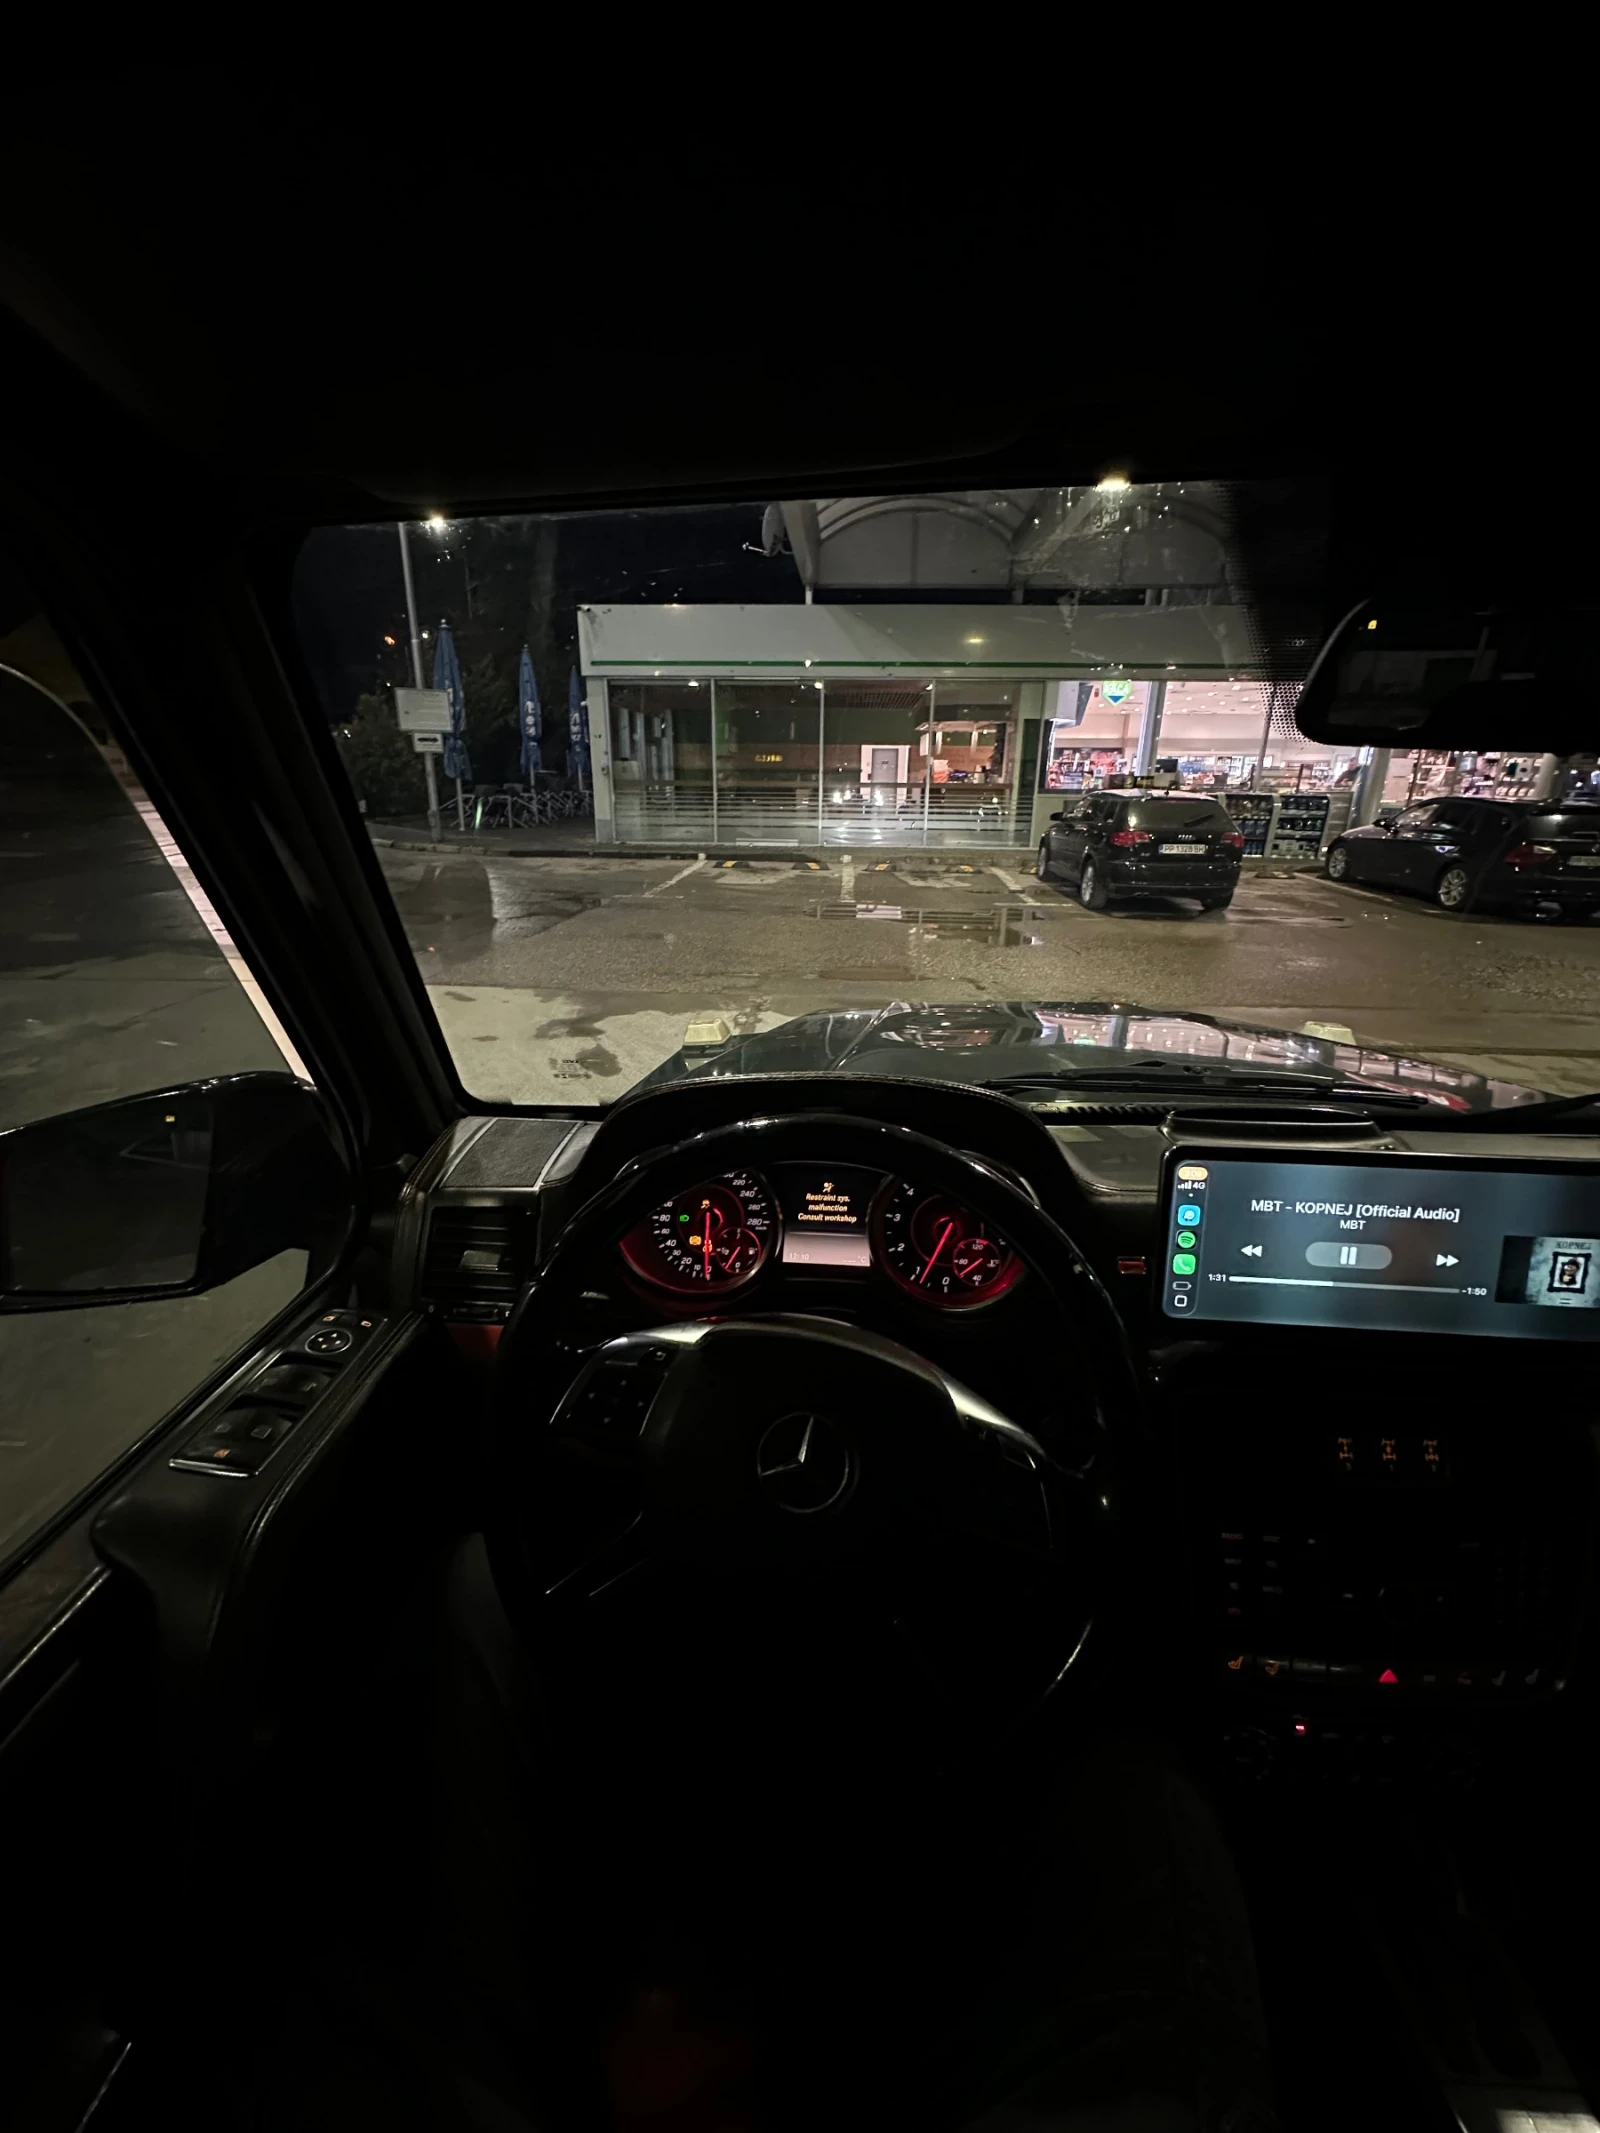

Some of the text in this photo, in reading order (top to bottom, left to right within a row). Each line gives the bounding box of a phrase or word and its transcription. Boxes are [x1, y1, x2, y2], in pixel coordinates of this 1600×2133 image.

[1192, 1181, 1205, 1190] 4G
[906, 1187, 915, 1196] 4
[805, 1193, 851, 1203] Restraint sys.
[808, 1203, 848, 1212] malfunction
[1251, 1199, 1283, 1213] MBT
[1296, 1202, 1353, 1217] KOPNEJ
[1356, 1203, 1411, 1220] [Official
[1413, 1206, 1460, 1223] Audio]
[659, 1213, 671, 1222] 80
[797, 1212, 858, 1224] Consult workshop
[893, 1213, 902, 1222] 3
[1339, 1220, 1366, 1230] MBT
[665, 1239, 677, 1247] 40
[897, 1243, 905, 1251] 2
[681, 1257, 692, 1265] 20
[915, 1266, 921, 1274] 1
[941, 1276, 950, 1285] 0
[1208, 1273, 1226, 1283] 1:31
